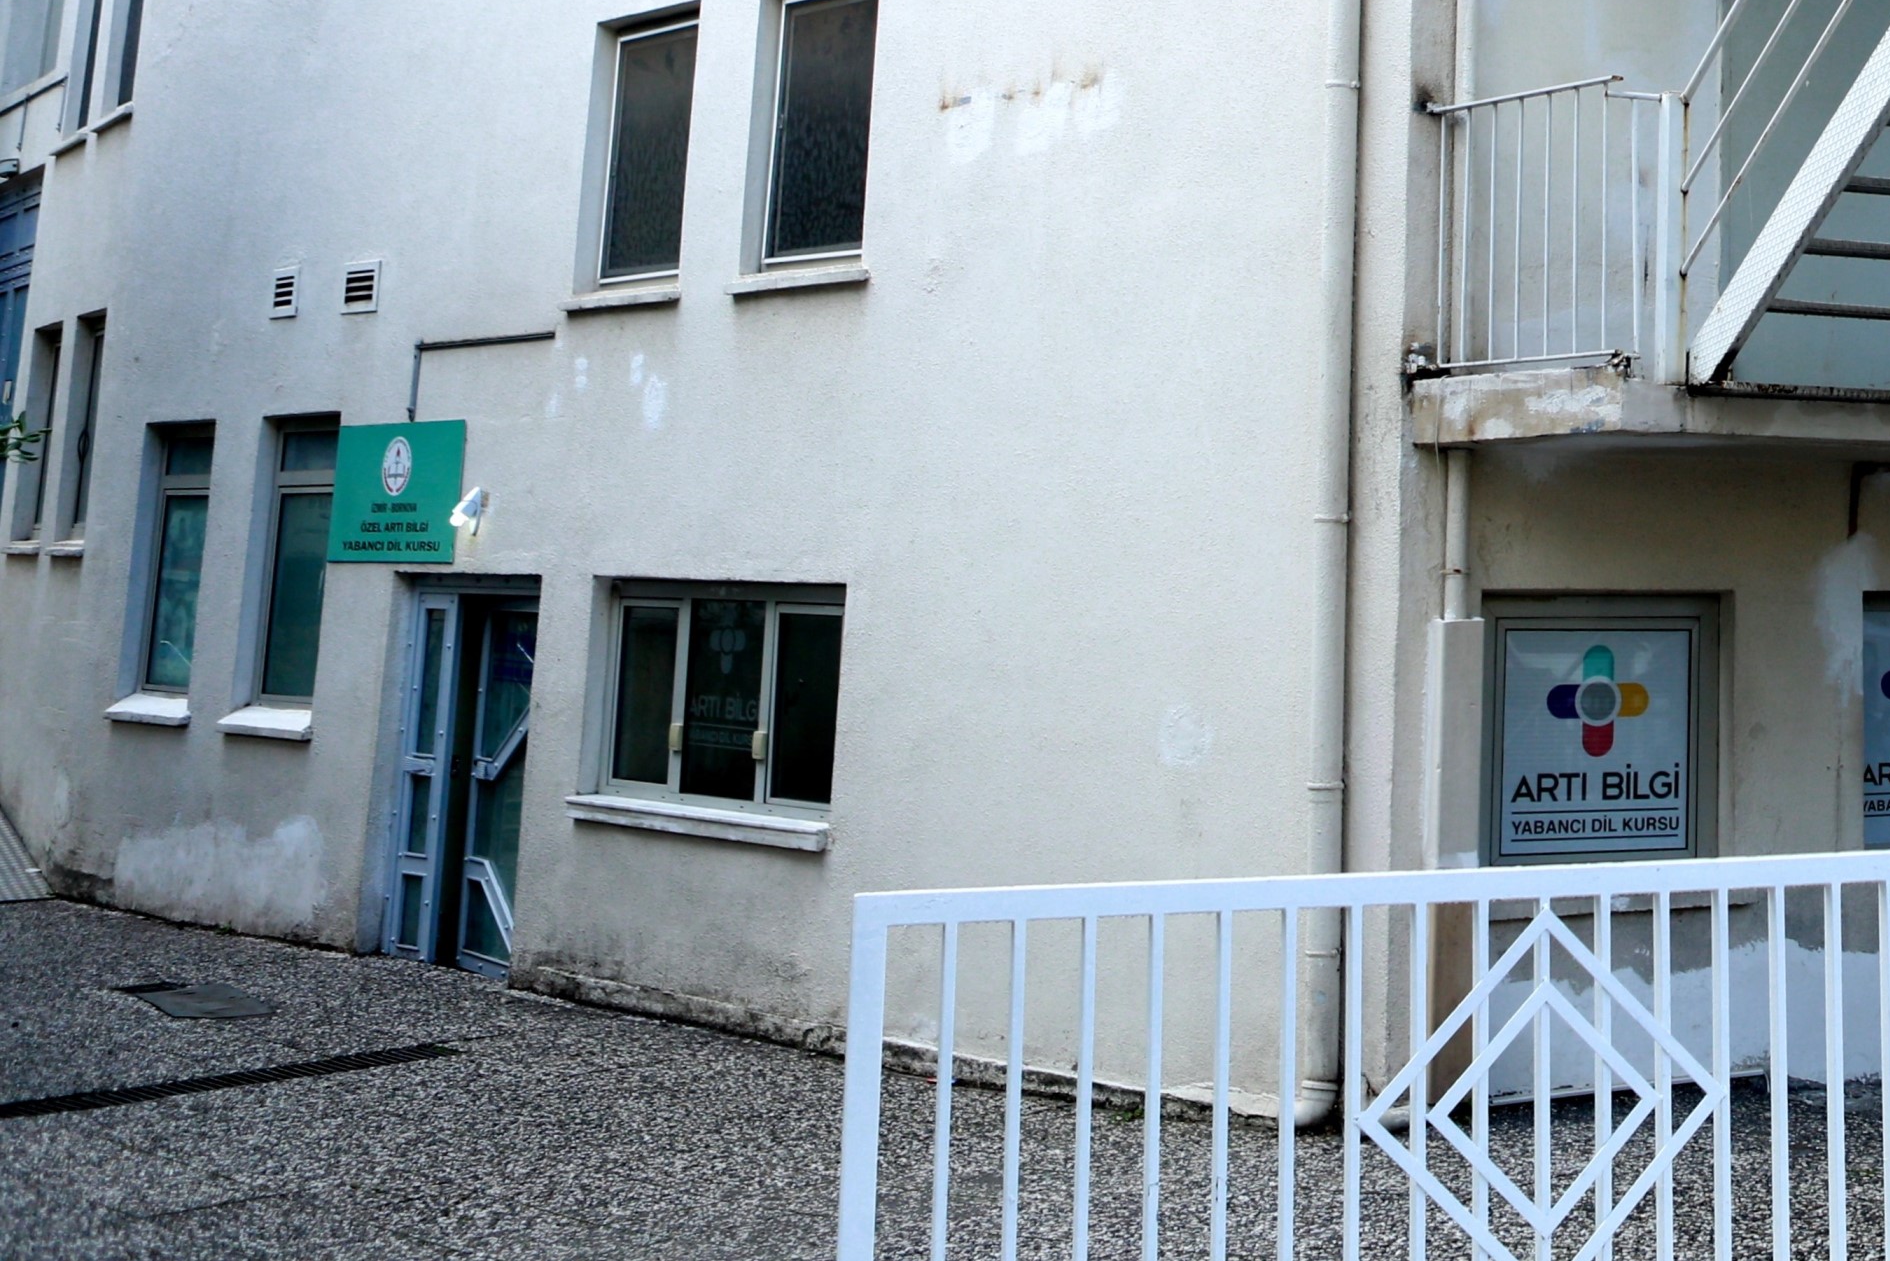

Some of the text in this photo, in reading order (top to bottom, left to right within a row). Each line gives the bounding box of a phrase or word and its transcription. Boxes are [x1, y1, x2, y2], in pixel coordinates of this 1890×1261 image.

[361, 520, 382, 532] ÖZEL
[384, 522, 403, 532] ARTI
[342, 539, 440, 551] YABANCI DİL KURSU
[725, 692, 760, 722] BİLG
[1510, 761, 1680, 804] ARTI BİLGİ
[1511, 813, 1680, 836] YABANCI DİL KURSU
